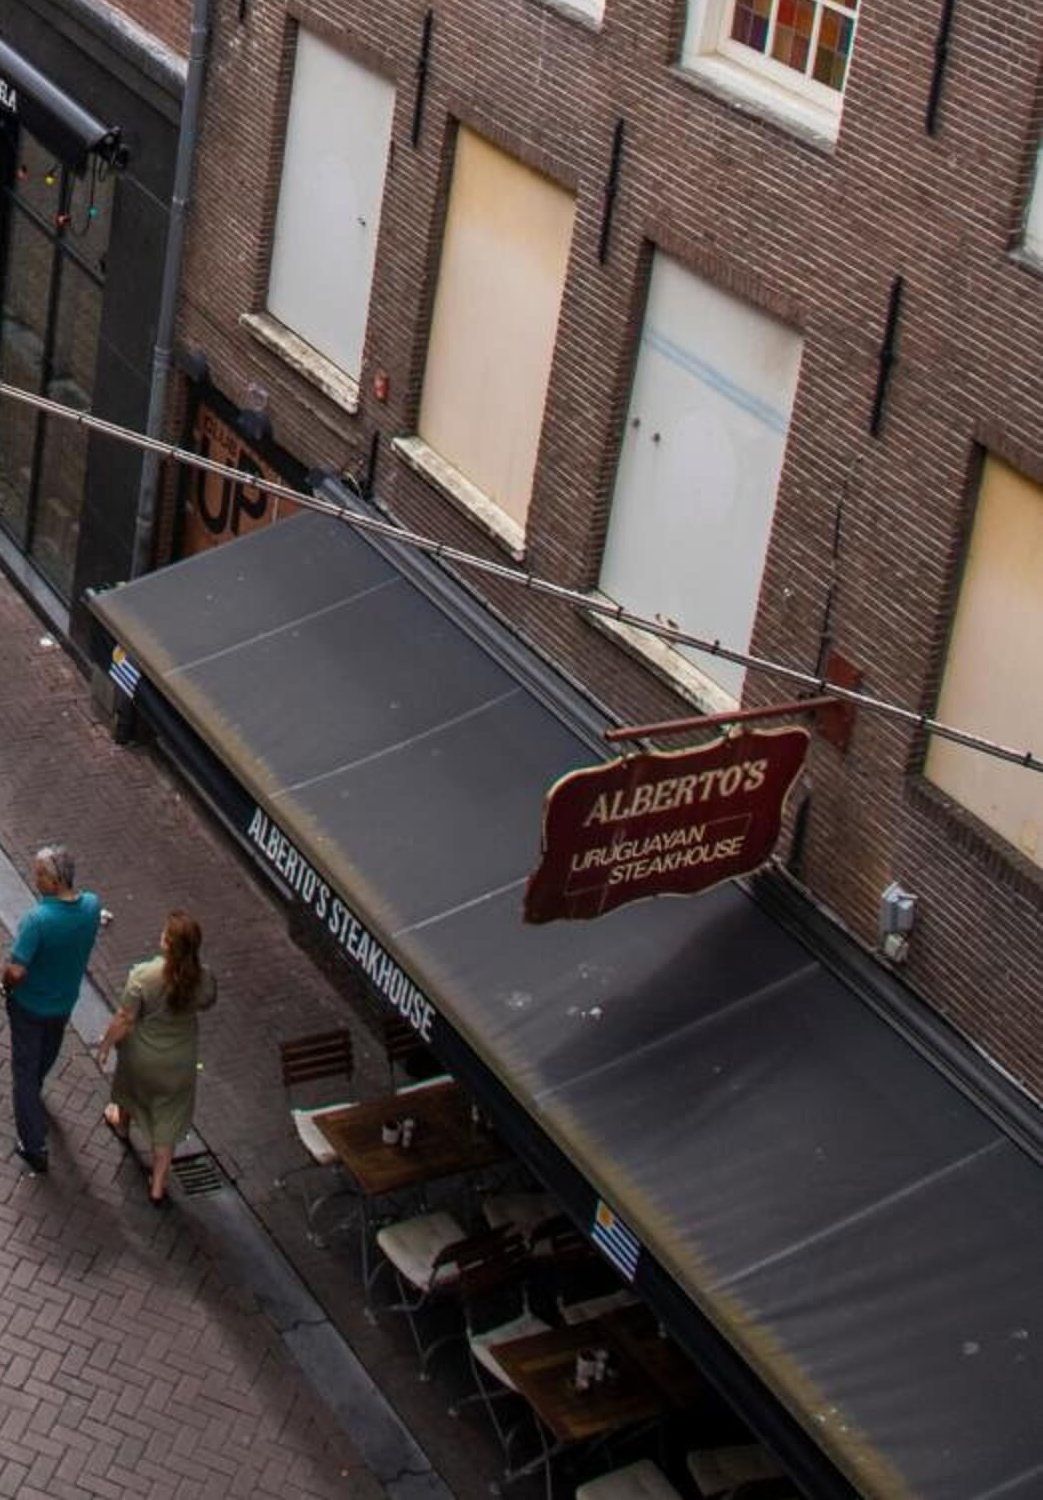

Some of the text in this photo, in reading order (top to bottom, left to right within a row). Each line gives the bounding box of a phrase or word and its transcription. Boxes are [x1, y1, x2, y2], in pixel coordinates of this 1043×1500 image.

[582, 758, 768, 827] ALBERTO'S
[571, 823, 707, 872] URUGUAYAN
[608, 835, 746, 886] STEAKHOUSE
[247, 807, 436, 1043] ALBERTO'S STEAKHOUSE
